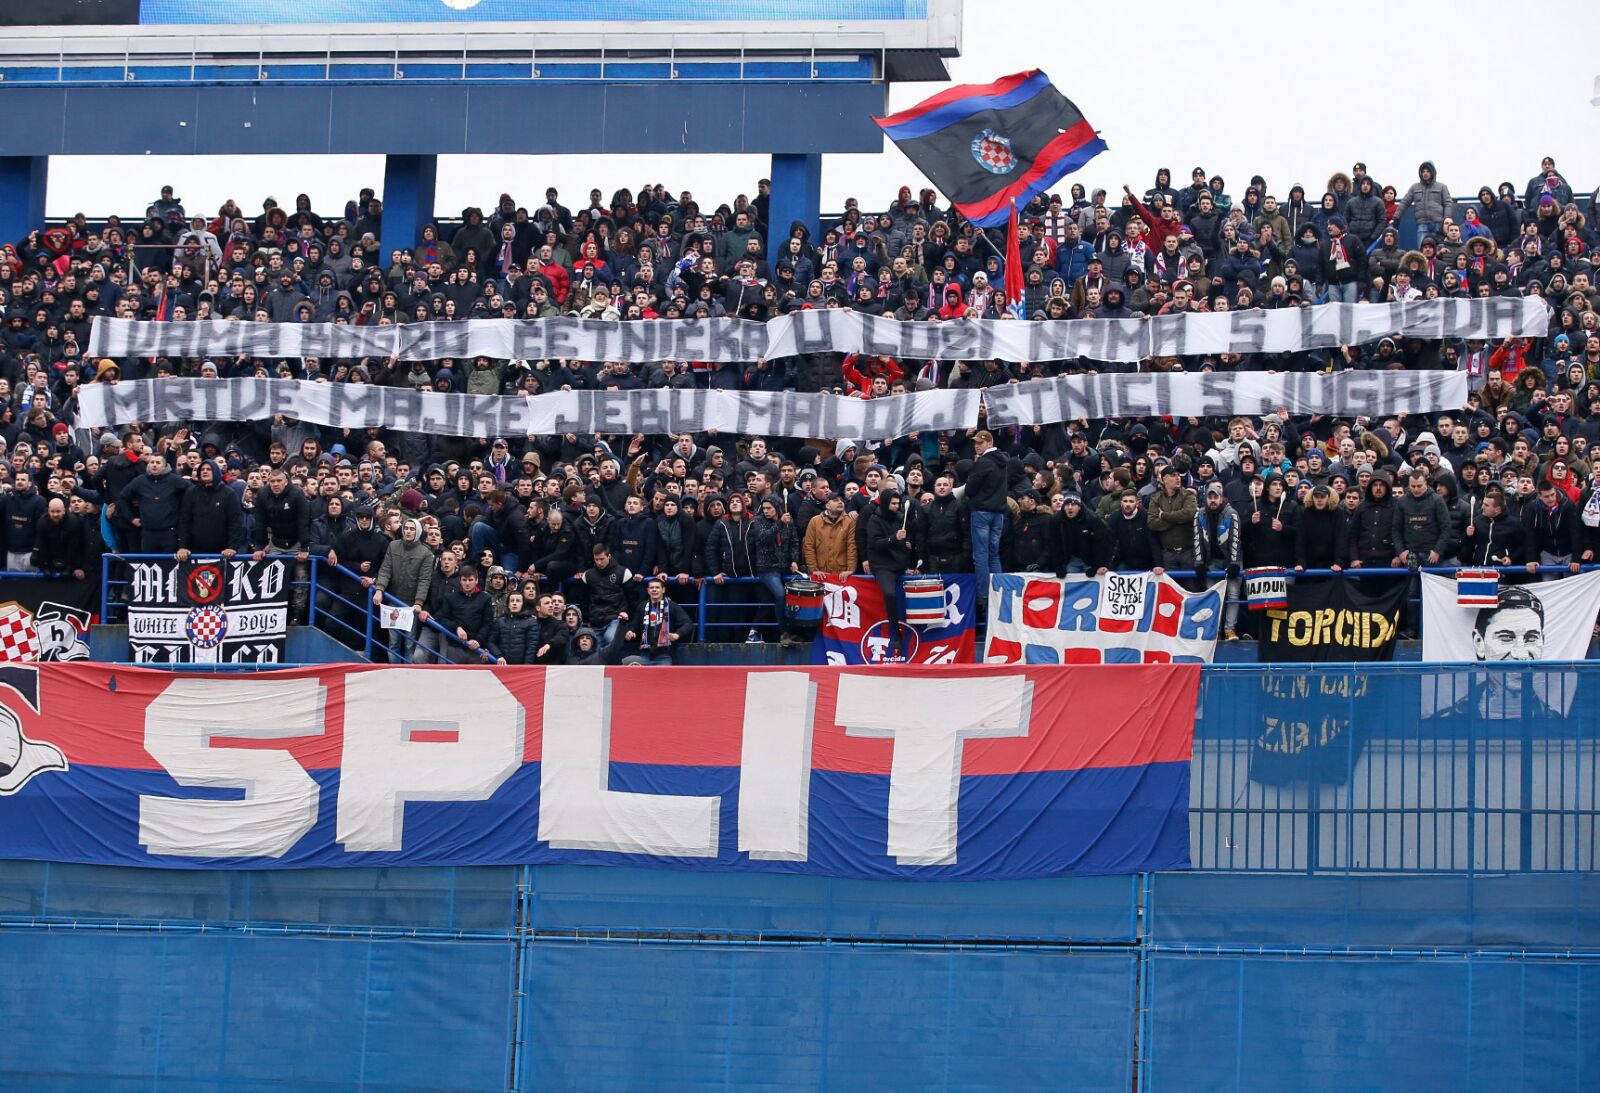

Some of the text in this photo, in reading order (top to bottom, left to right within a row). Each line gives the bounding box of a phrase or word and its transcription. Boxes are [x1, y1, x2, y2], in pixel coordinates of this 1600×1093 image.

[127, 320, 280, 357] VAMA
[792, 309, 834, 354] U
[1029, 314, 1187, 361] NAMA
[1228, 310, 1266, 354] S
[102, 377, 301, 426] MRTVE
[329, 382, 532, 436] MAJKE
[554, 389, 707, 436] JEBU
[1201, 371, 1237, 416] S
[1108, 575, 1143, 593] SRK!
[1108, 591, 1121, 603] UZ
[1111, 603, 1136, 616] SMO
[133, 613, 278, 634] WHITE BOYS
[191, 637, 220, 649] SPLIT
[138, 665, 1036, 866] SPLIT
